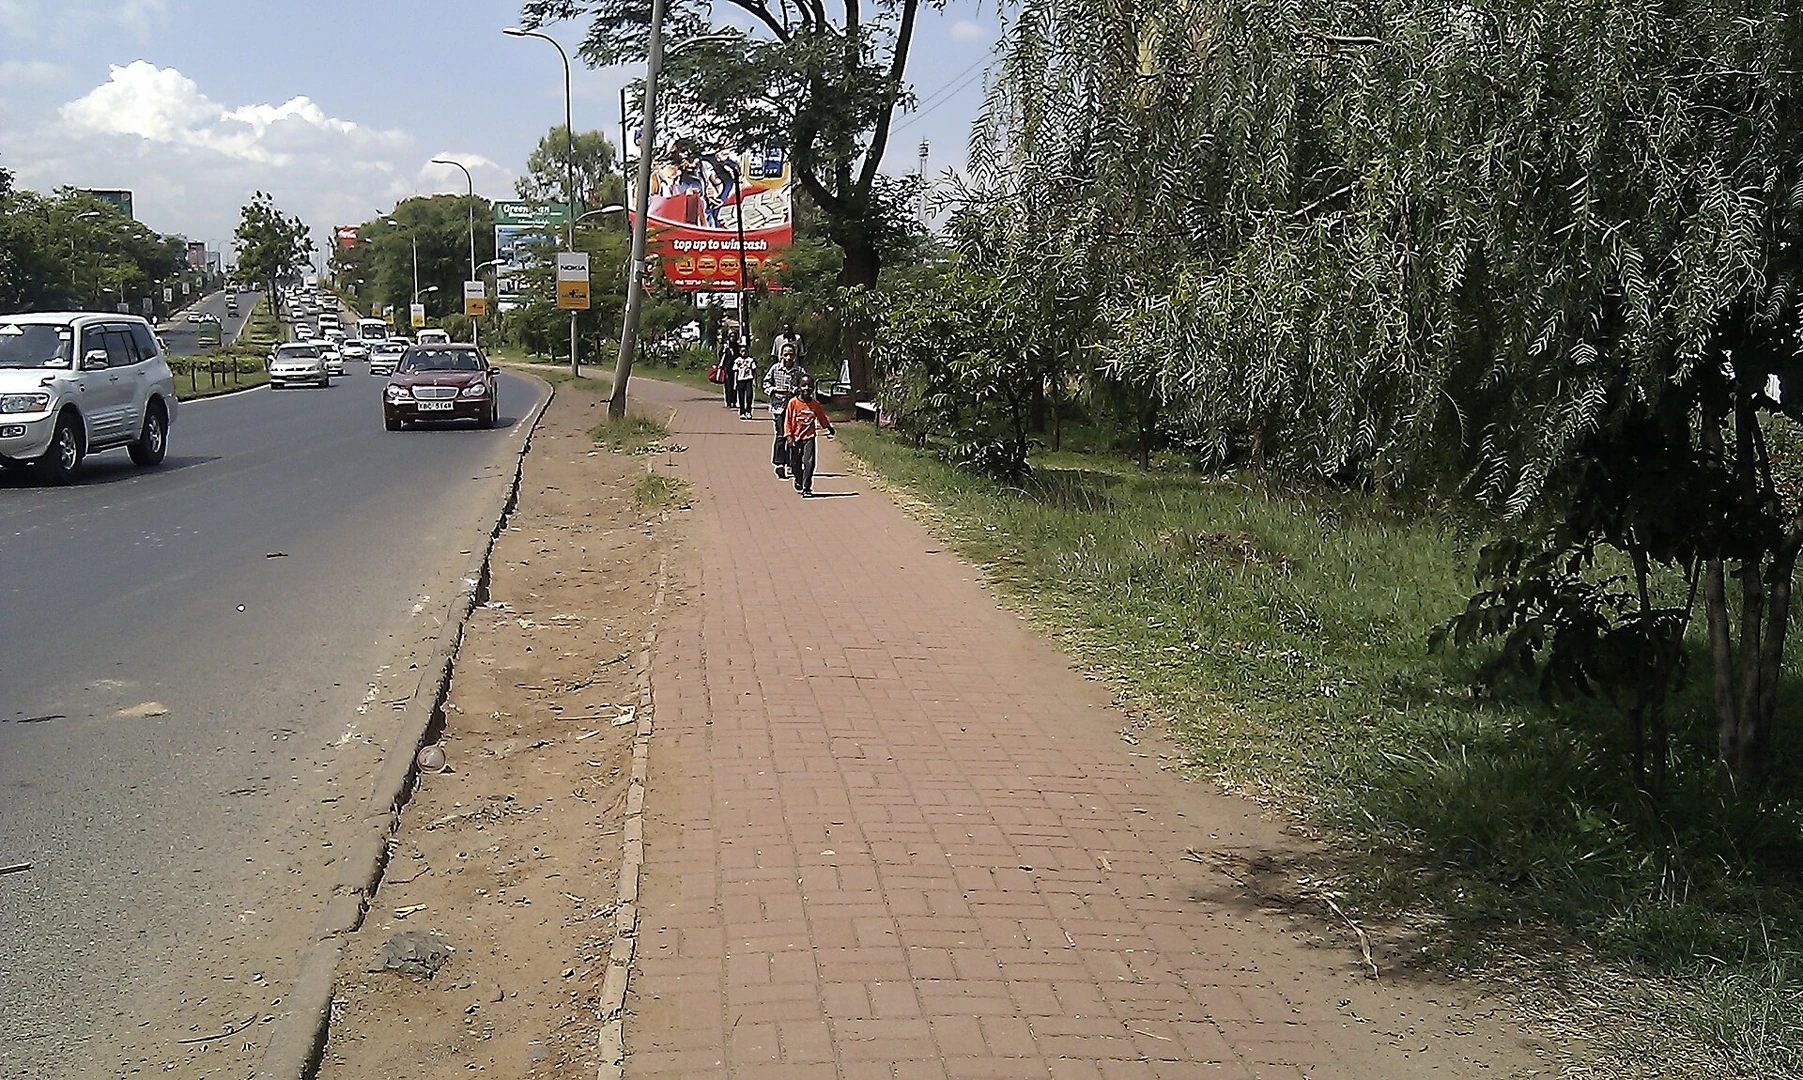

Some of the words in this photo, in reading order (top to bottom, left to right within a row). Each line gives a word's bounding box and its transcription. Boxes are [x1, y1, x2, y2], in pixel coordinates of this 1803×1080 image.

[674, 239, 692, 252] top
[692, 240, 707, 252] up
[708, 240, 720, 250] to
[721, 238, 740, 250] win
[743, 239, 767, 250] cash
